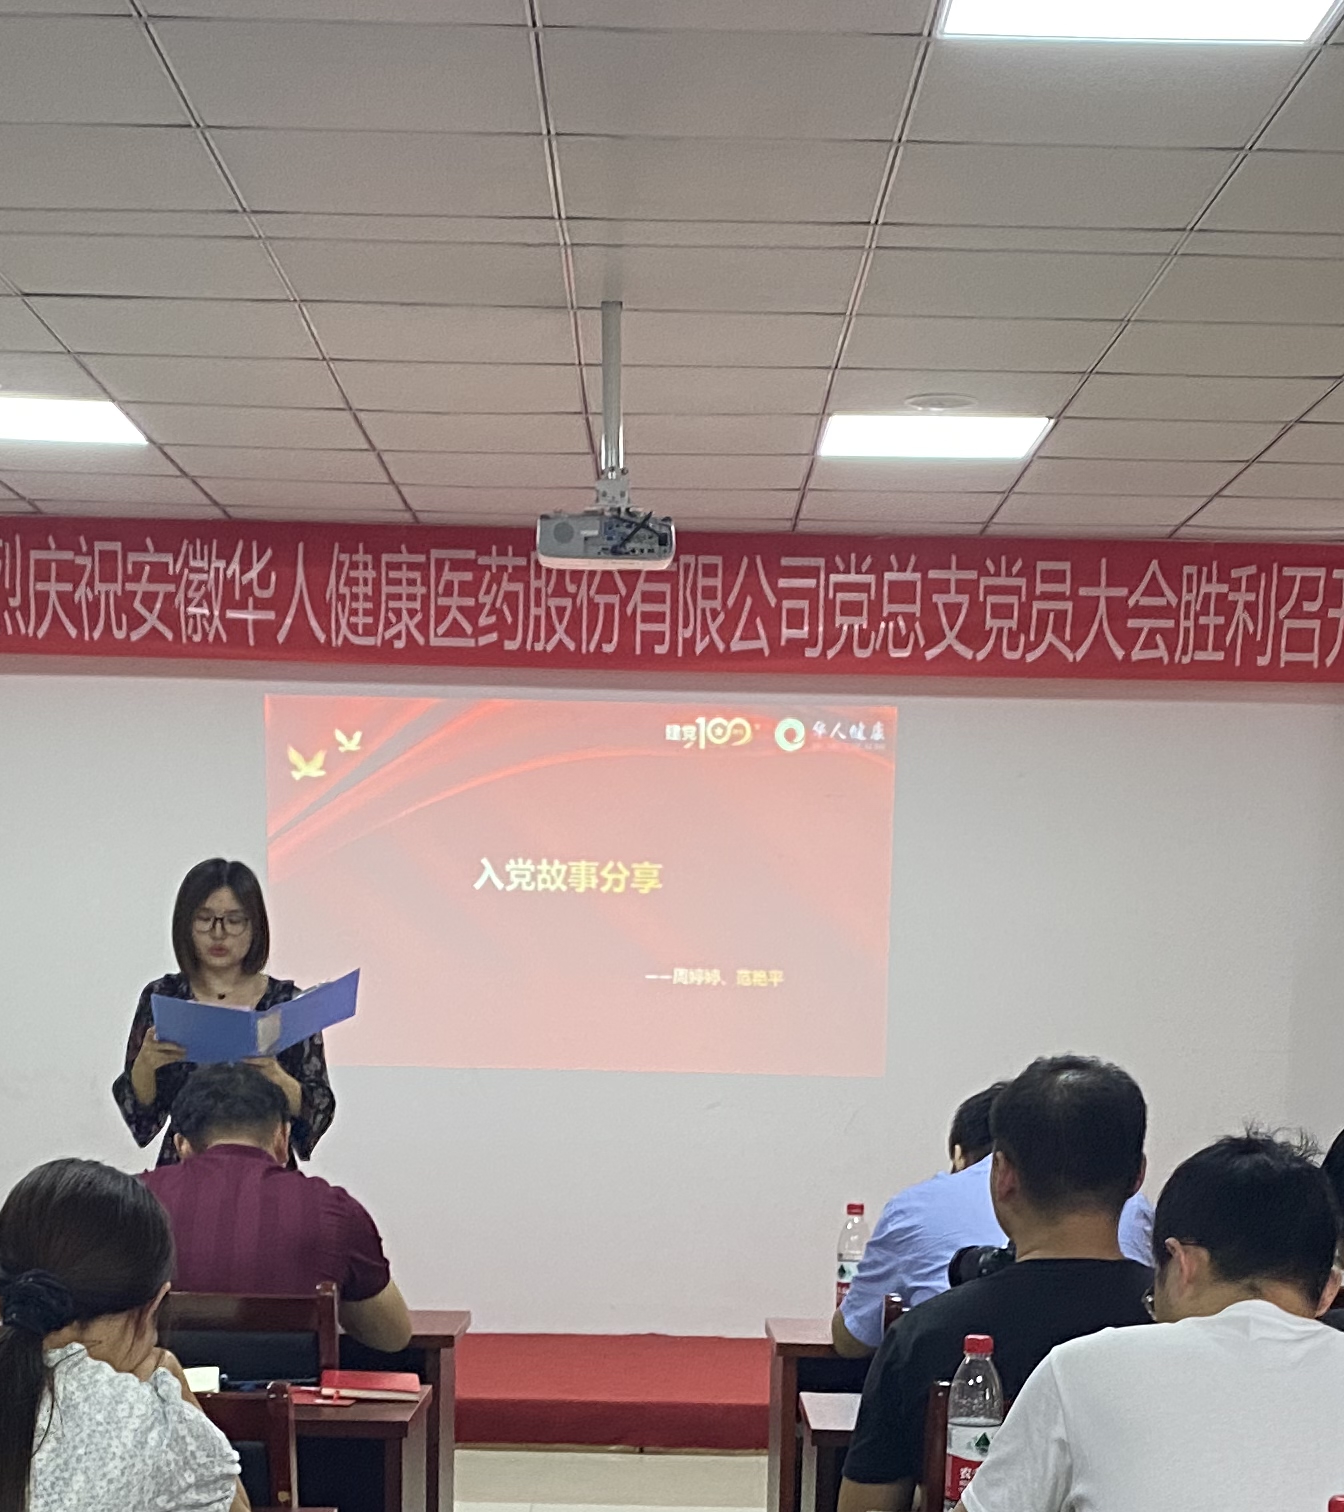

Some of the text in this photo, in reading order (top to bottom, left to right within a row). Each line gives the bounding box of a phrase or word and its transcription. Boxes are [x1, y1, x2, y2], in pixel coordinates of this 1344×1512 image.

[472, 857, 663, 894] 入党故事分享
